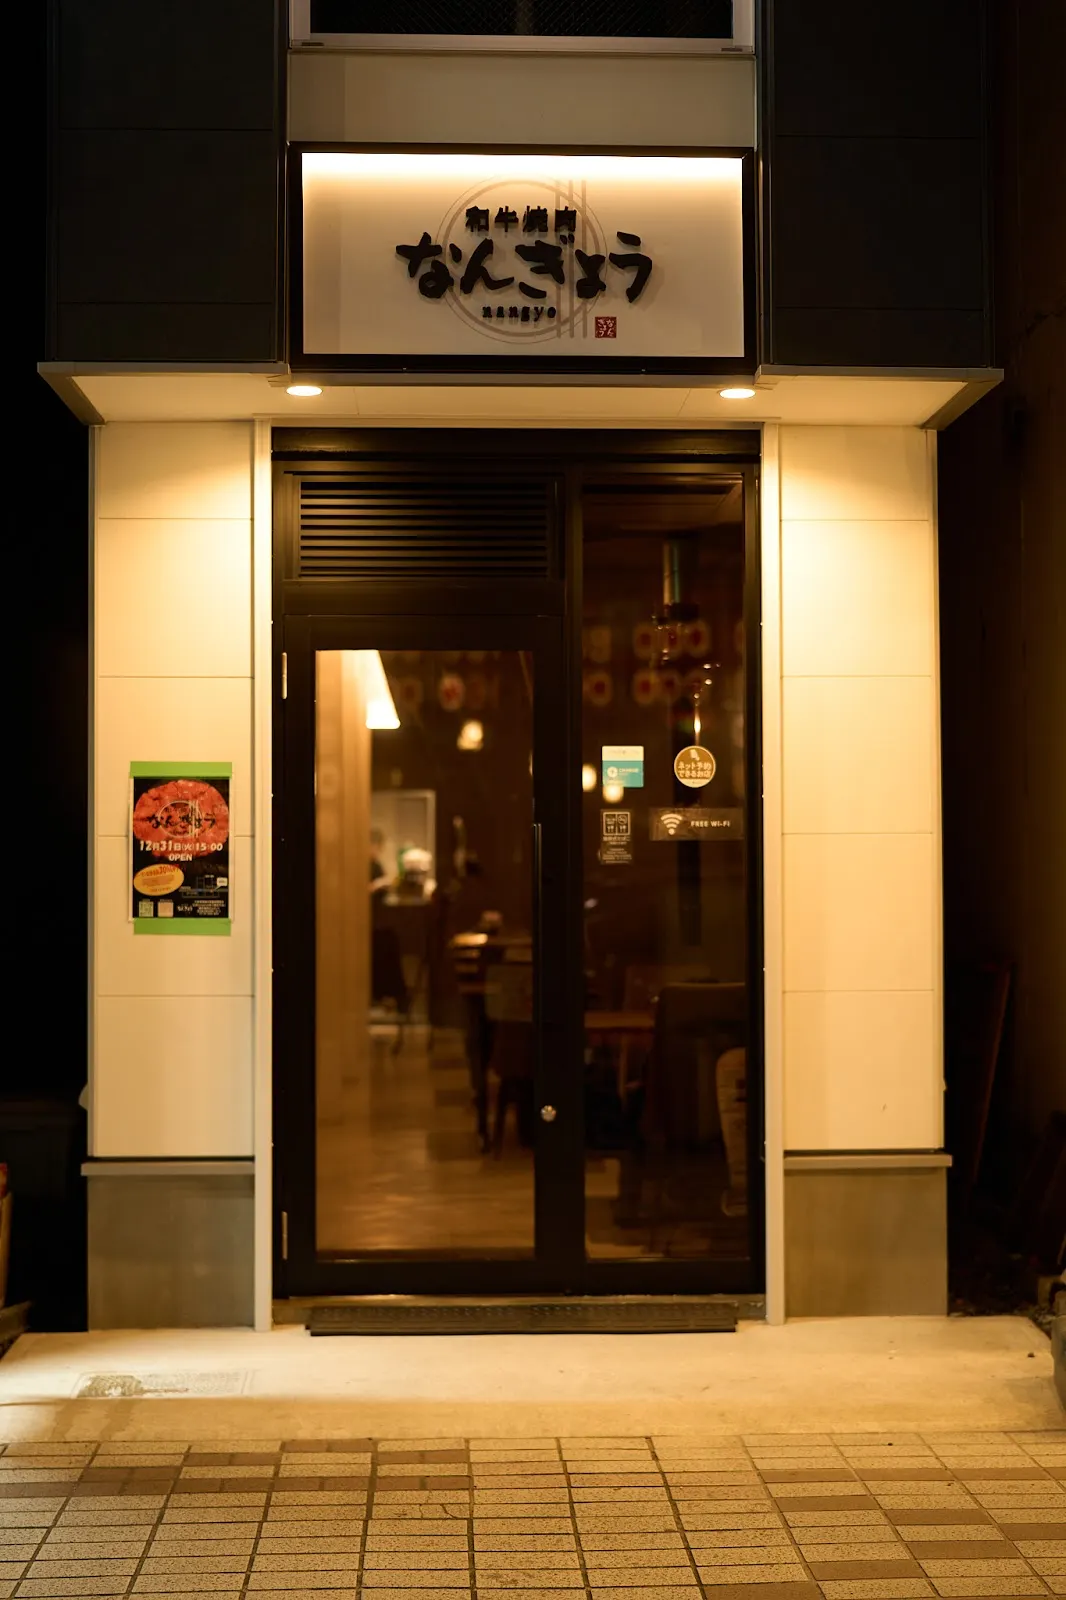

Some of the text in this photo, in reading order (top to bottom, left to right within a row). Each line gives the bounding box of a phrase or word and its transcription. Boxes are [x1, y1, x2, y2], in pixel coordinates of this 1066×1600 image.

[465, 205, 577, 232] 和牛焼肉
[396, 232, 653, 303] なんぎょう
[482, 306, 557, 322] nangyo
[168, 853, 193, 861] OPEN
